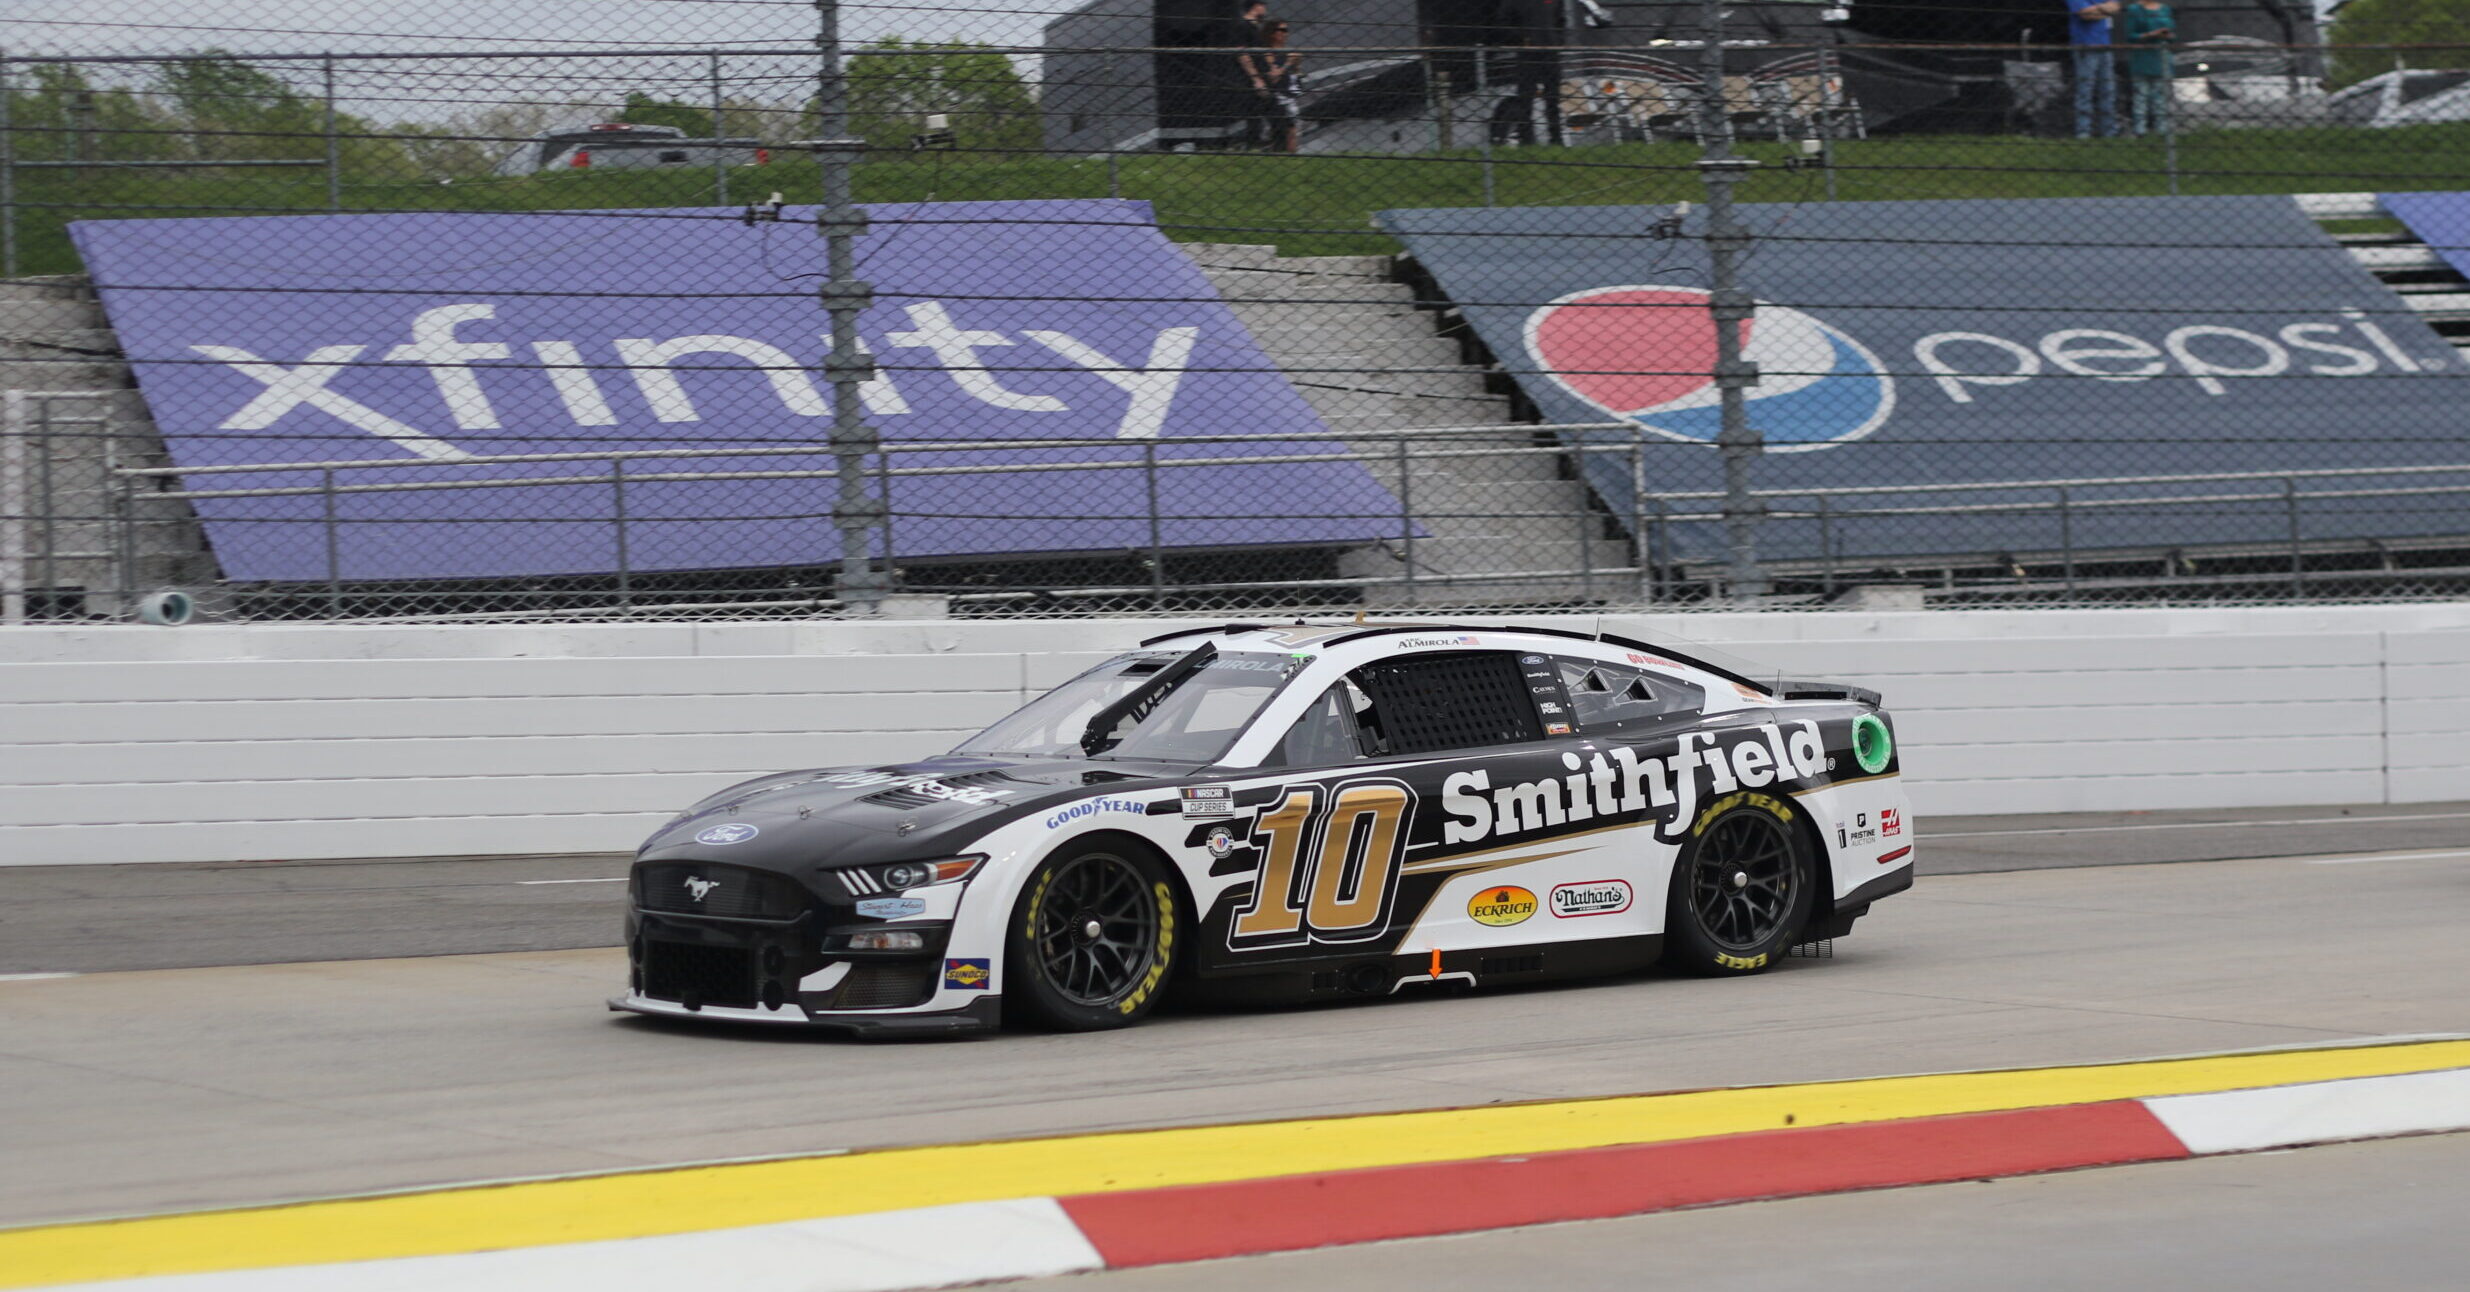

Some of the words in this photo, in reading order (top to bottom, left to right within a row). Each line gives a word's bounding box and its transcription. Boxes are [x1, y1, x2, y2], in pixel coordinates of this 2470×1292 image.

[1913, 306, 2421, 402] pepsi
[190, 302, 1198, 463] xfinity
[1398, 639, 1460, 649] ALMIROLA
[1442, 718, 1828, 845] Smithfield
[1195, 788, 1224, 798] NASCAR
[1189, 802, 1203, 812] CUP
[1204, 802, 1227, 812] SERIES
[702, 825, 749, 842] Ford
[1850, 828, 1876, 839] PRISTINE
[1229, 779, 1413, 946] 10
[1555, 886, 1623, 906] Nathan's
[1473, 902, 1533, 917] ECKRICH
[949, 968, 988, 980] SUNOCO
